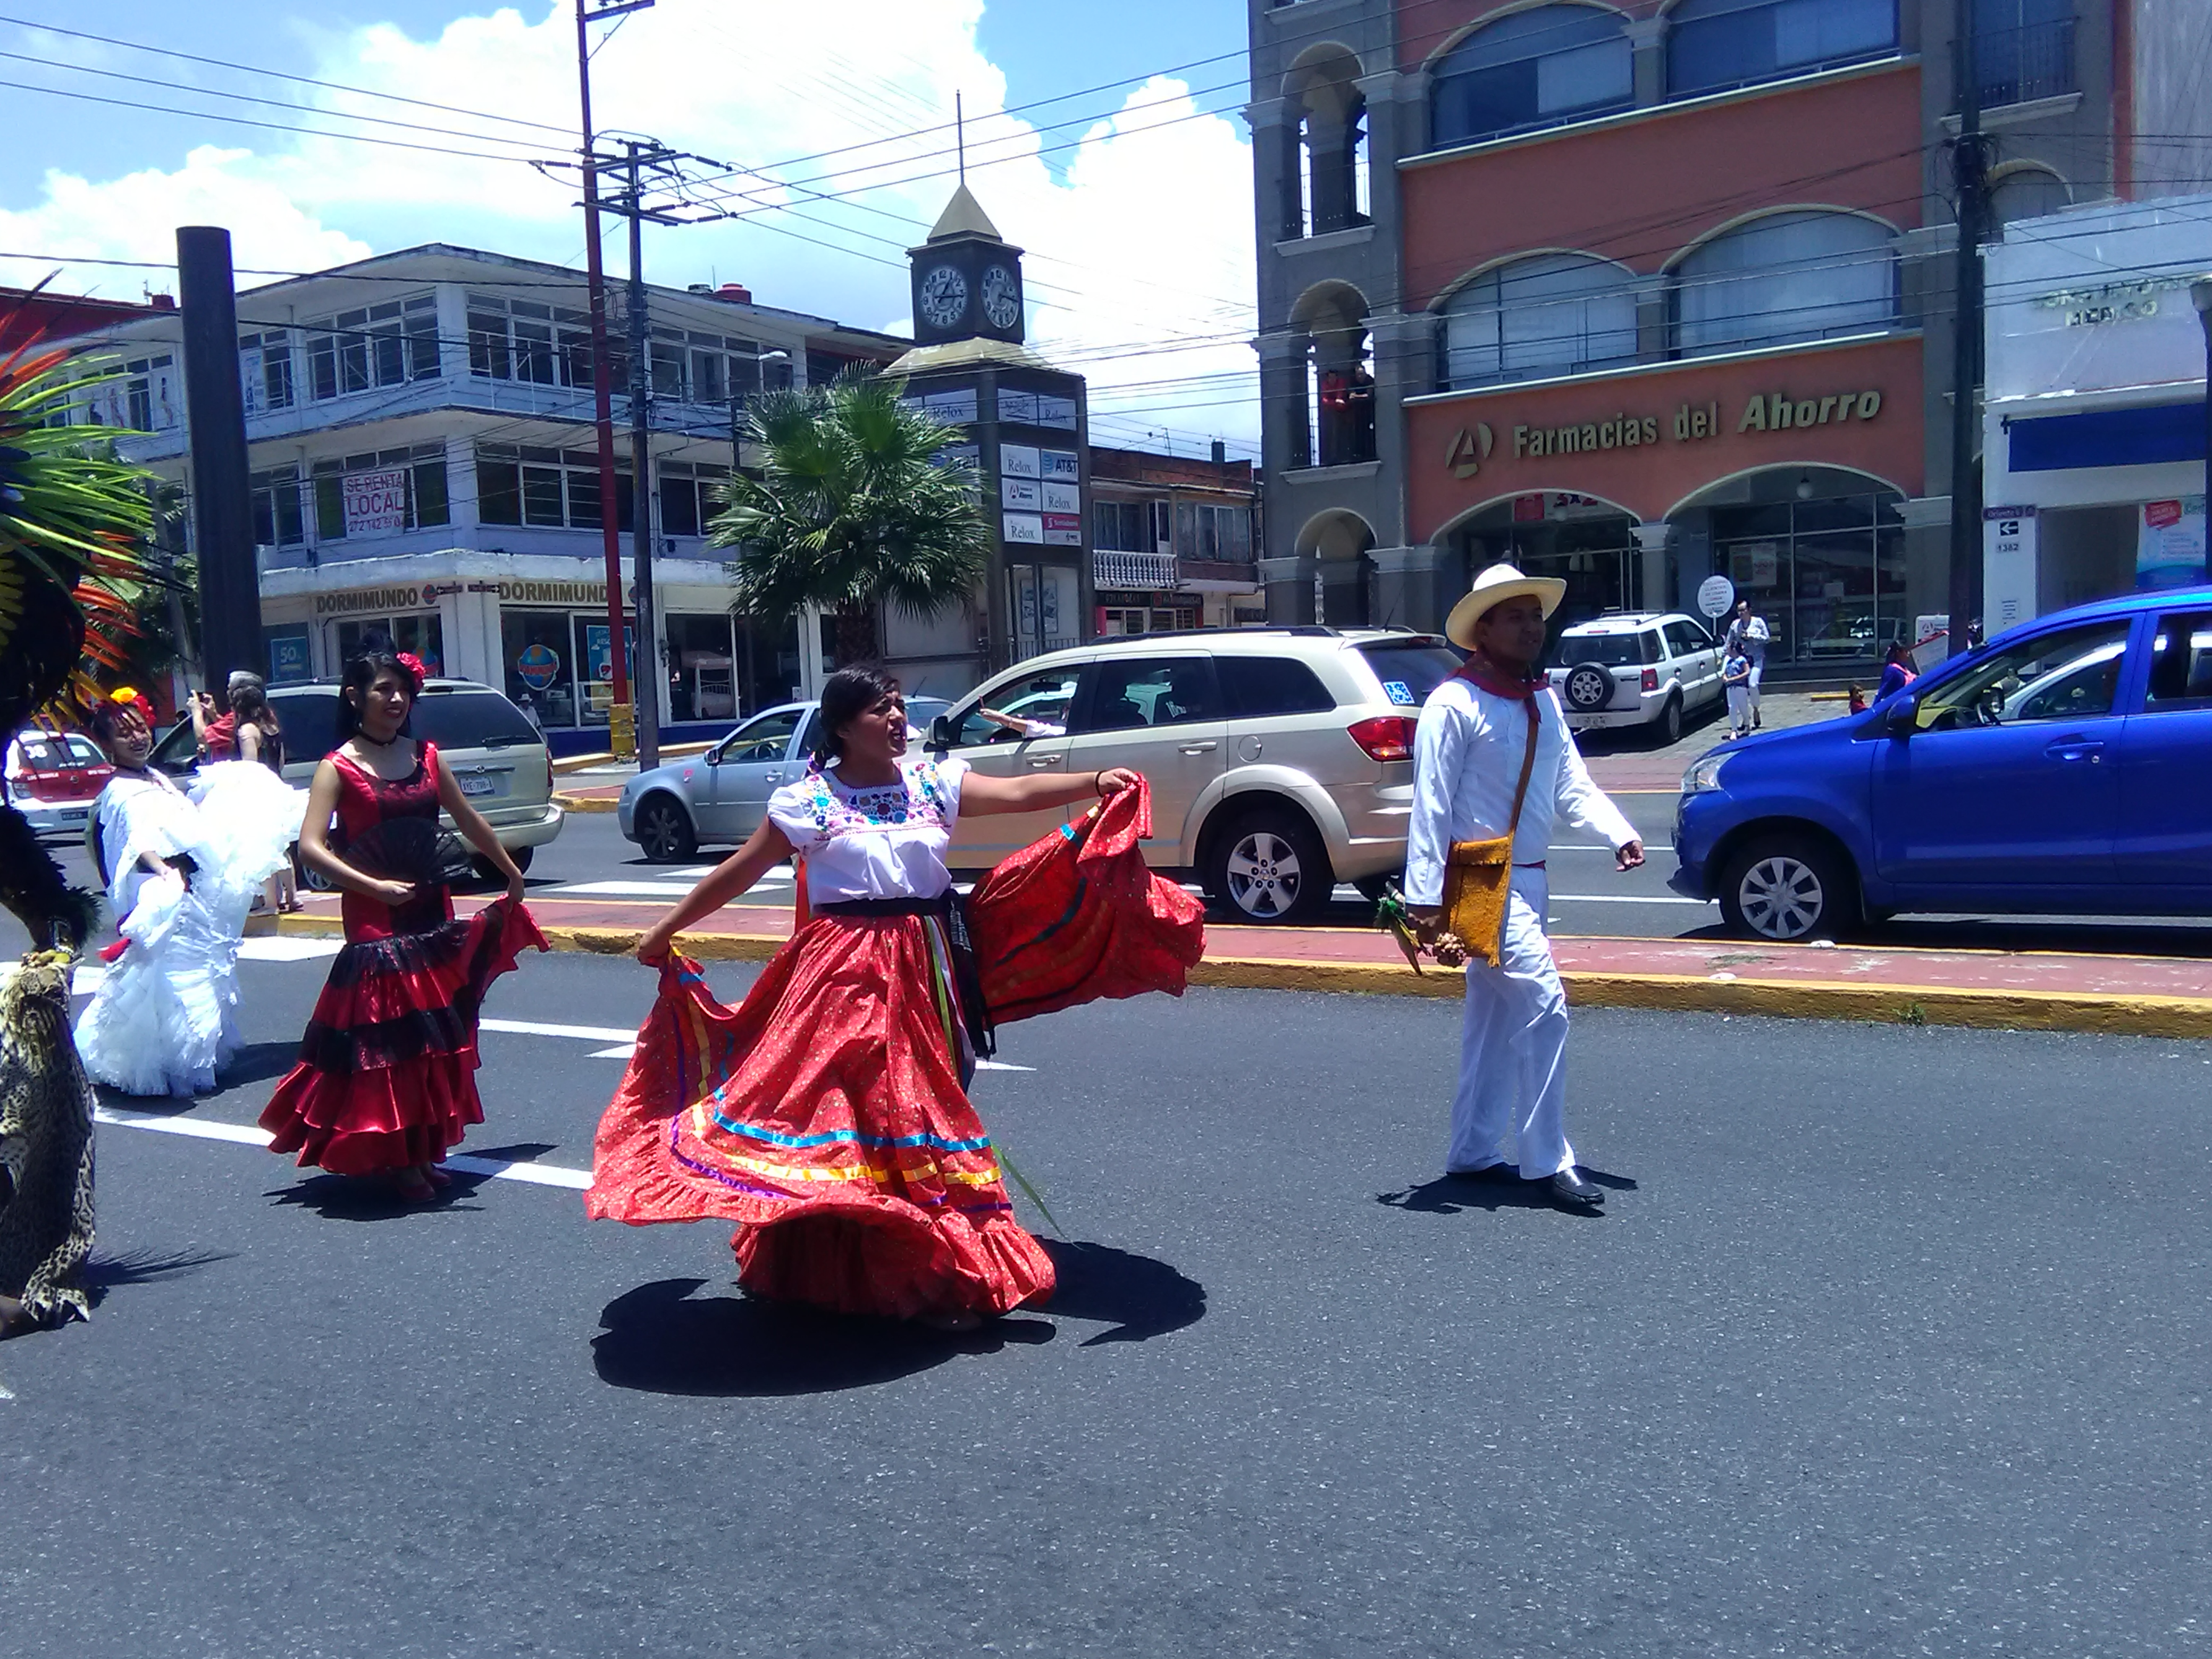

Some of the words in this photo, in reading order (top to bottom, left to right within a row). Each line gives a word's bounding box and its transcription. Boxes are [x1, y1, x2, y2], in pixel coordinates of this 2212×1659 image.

[932, 407, 964, 419] Relox
[1044, 409, 1068, 423] Relox
[1513, 411, 1658, 459] Farmacias
[1674, 401, 1720, 442] del
[1737, 389, 1881, 435] Ahorro
[1008, 458, 1032, 473] Relox
[1055, 459, 1078, 473] AT&T
[347, 478, 362, 492] SE
[364, 473, 404, 490] RENTA
[347, 492, 404, 516] LOCAL
[1048, 495, 1071, 509] Relox
[1011, 525, 1035, 539] Relox
[316, 586, 418, 613] DORMIMUNDO
[499, 582, 608, 602] DORMIMUND
